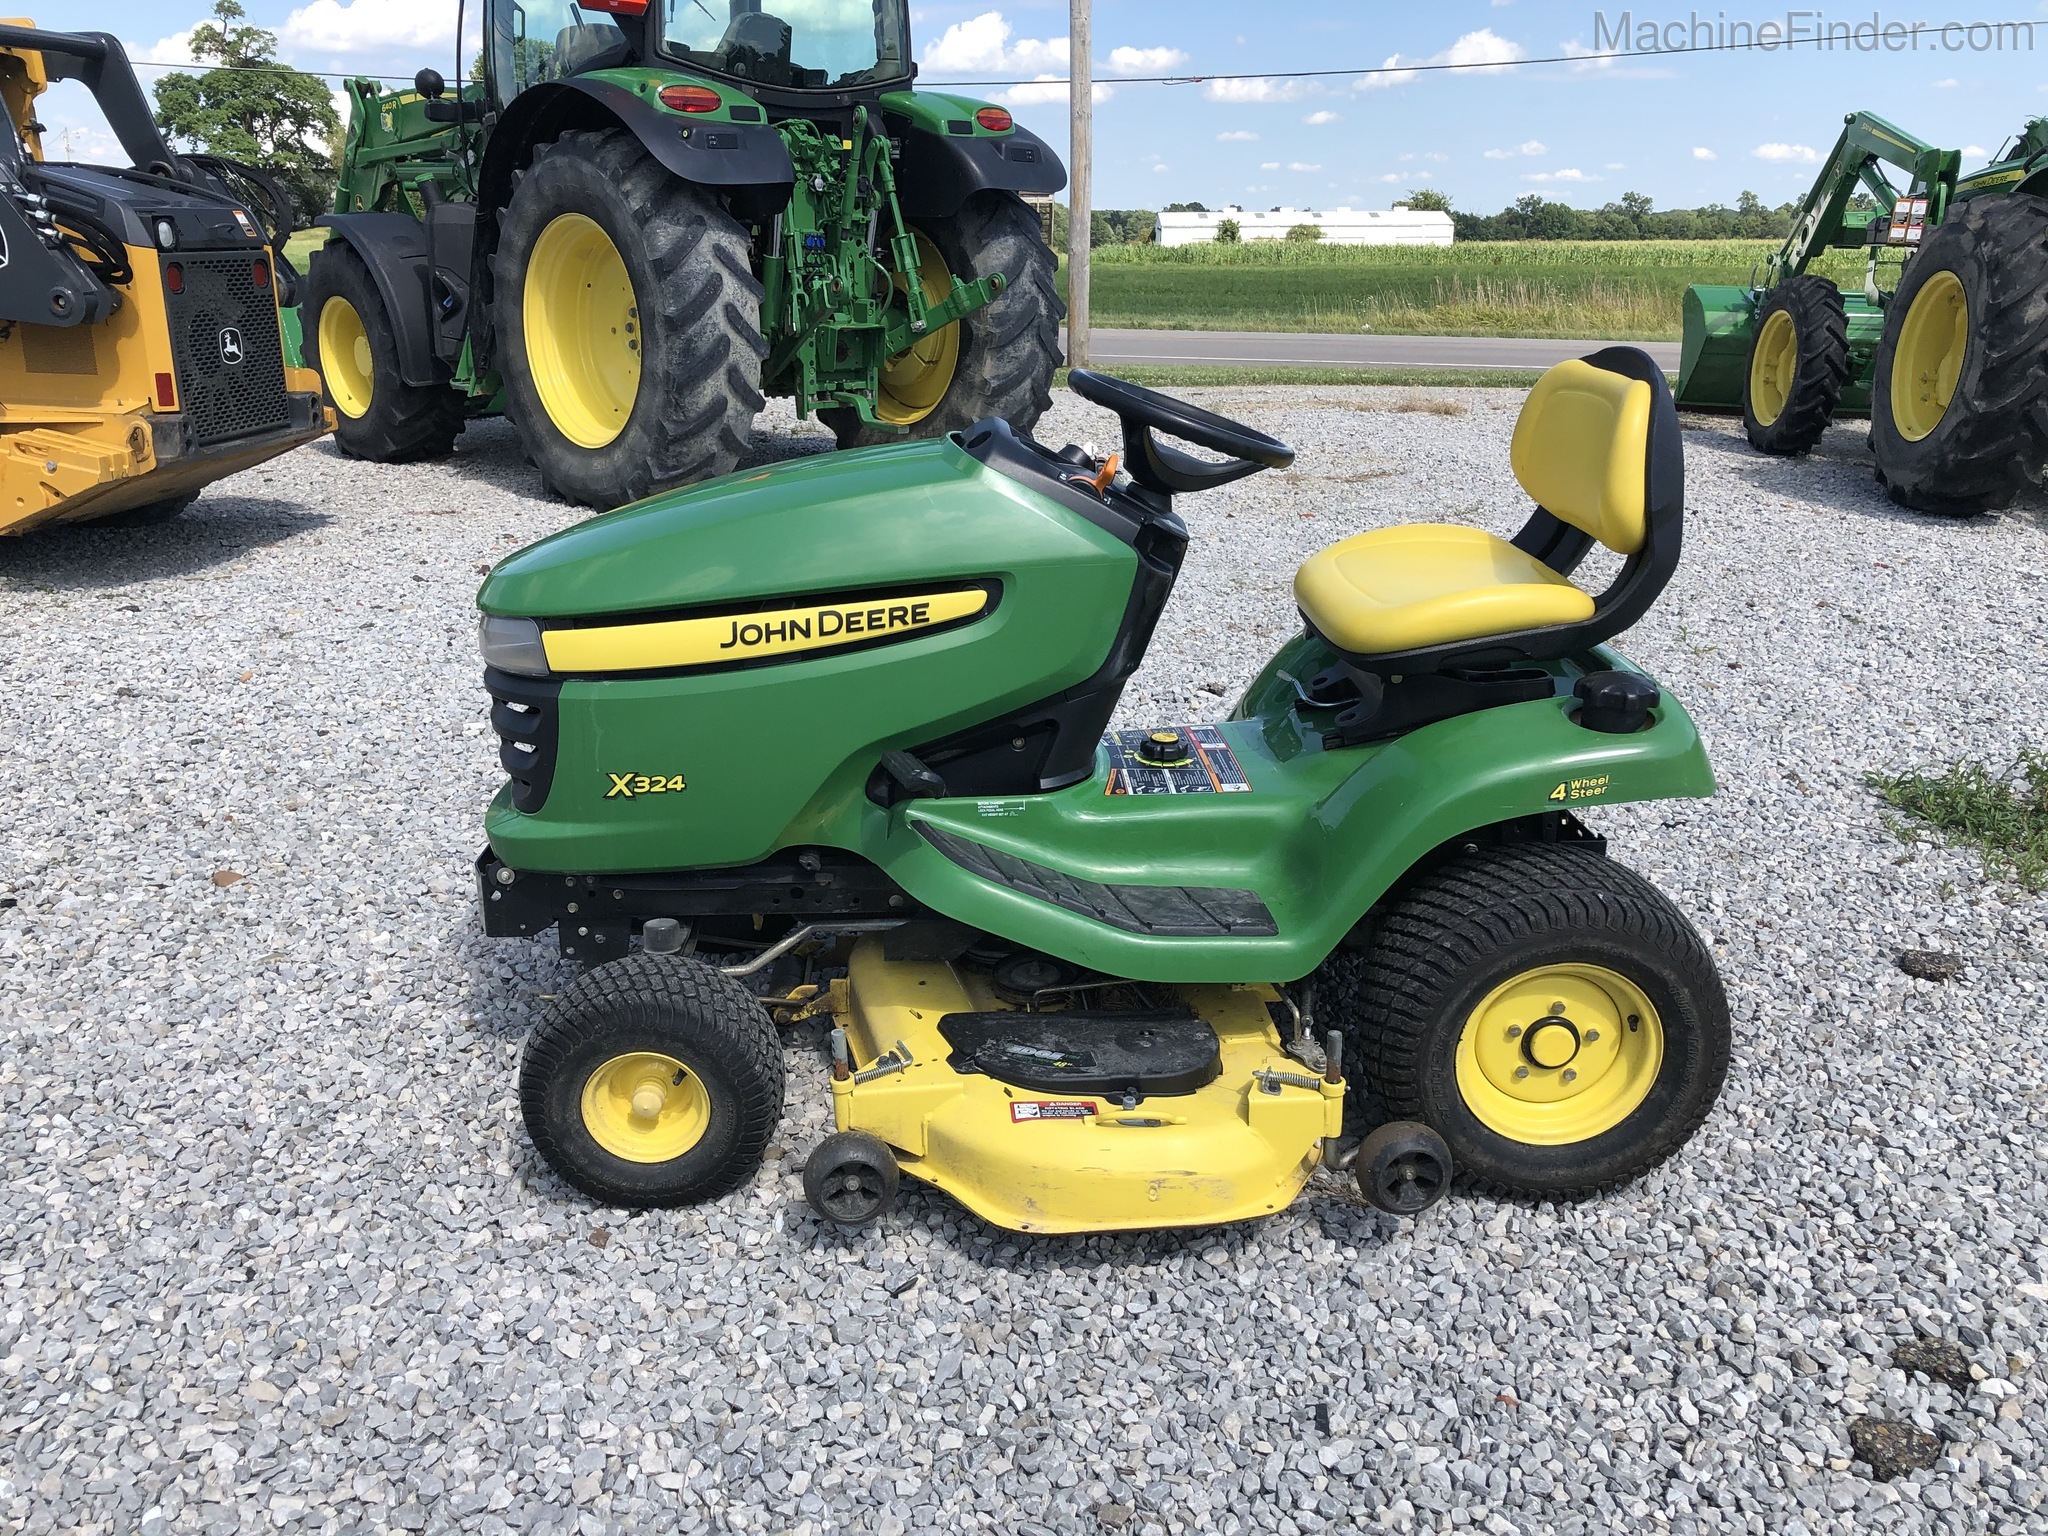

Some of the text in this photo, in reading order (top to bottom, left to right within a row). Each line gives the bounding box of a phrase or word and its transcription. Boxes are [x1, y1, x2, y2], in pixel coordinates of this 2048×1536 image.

[720, 602, 930, 648] JOHN DEERE
[602, 772, 687, 800] X324
[1549, 774, 1610, 801] 4 Wheel
[1569, 786, 1609, 800] Steer
